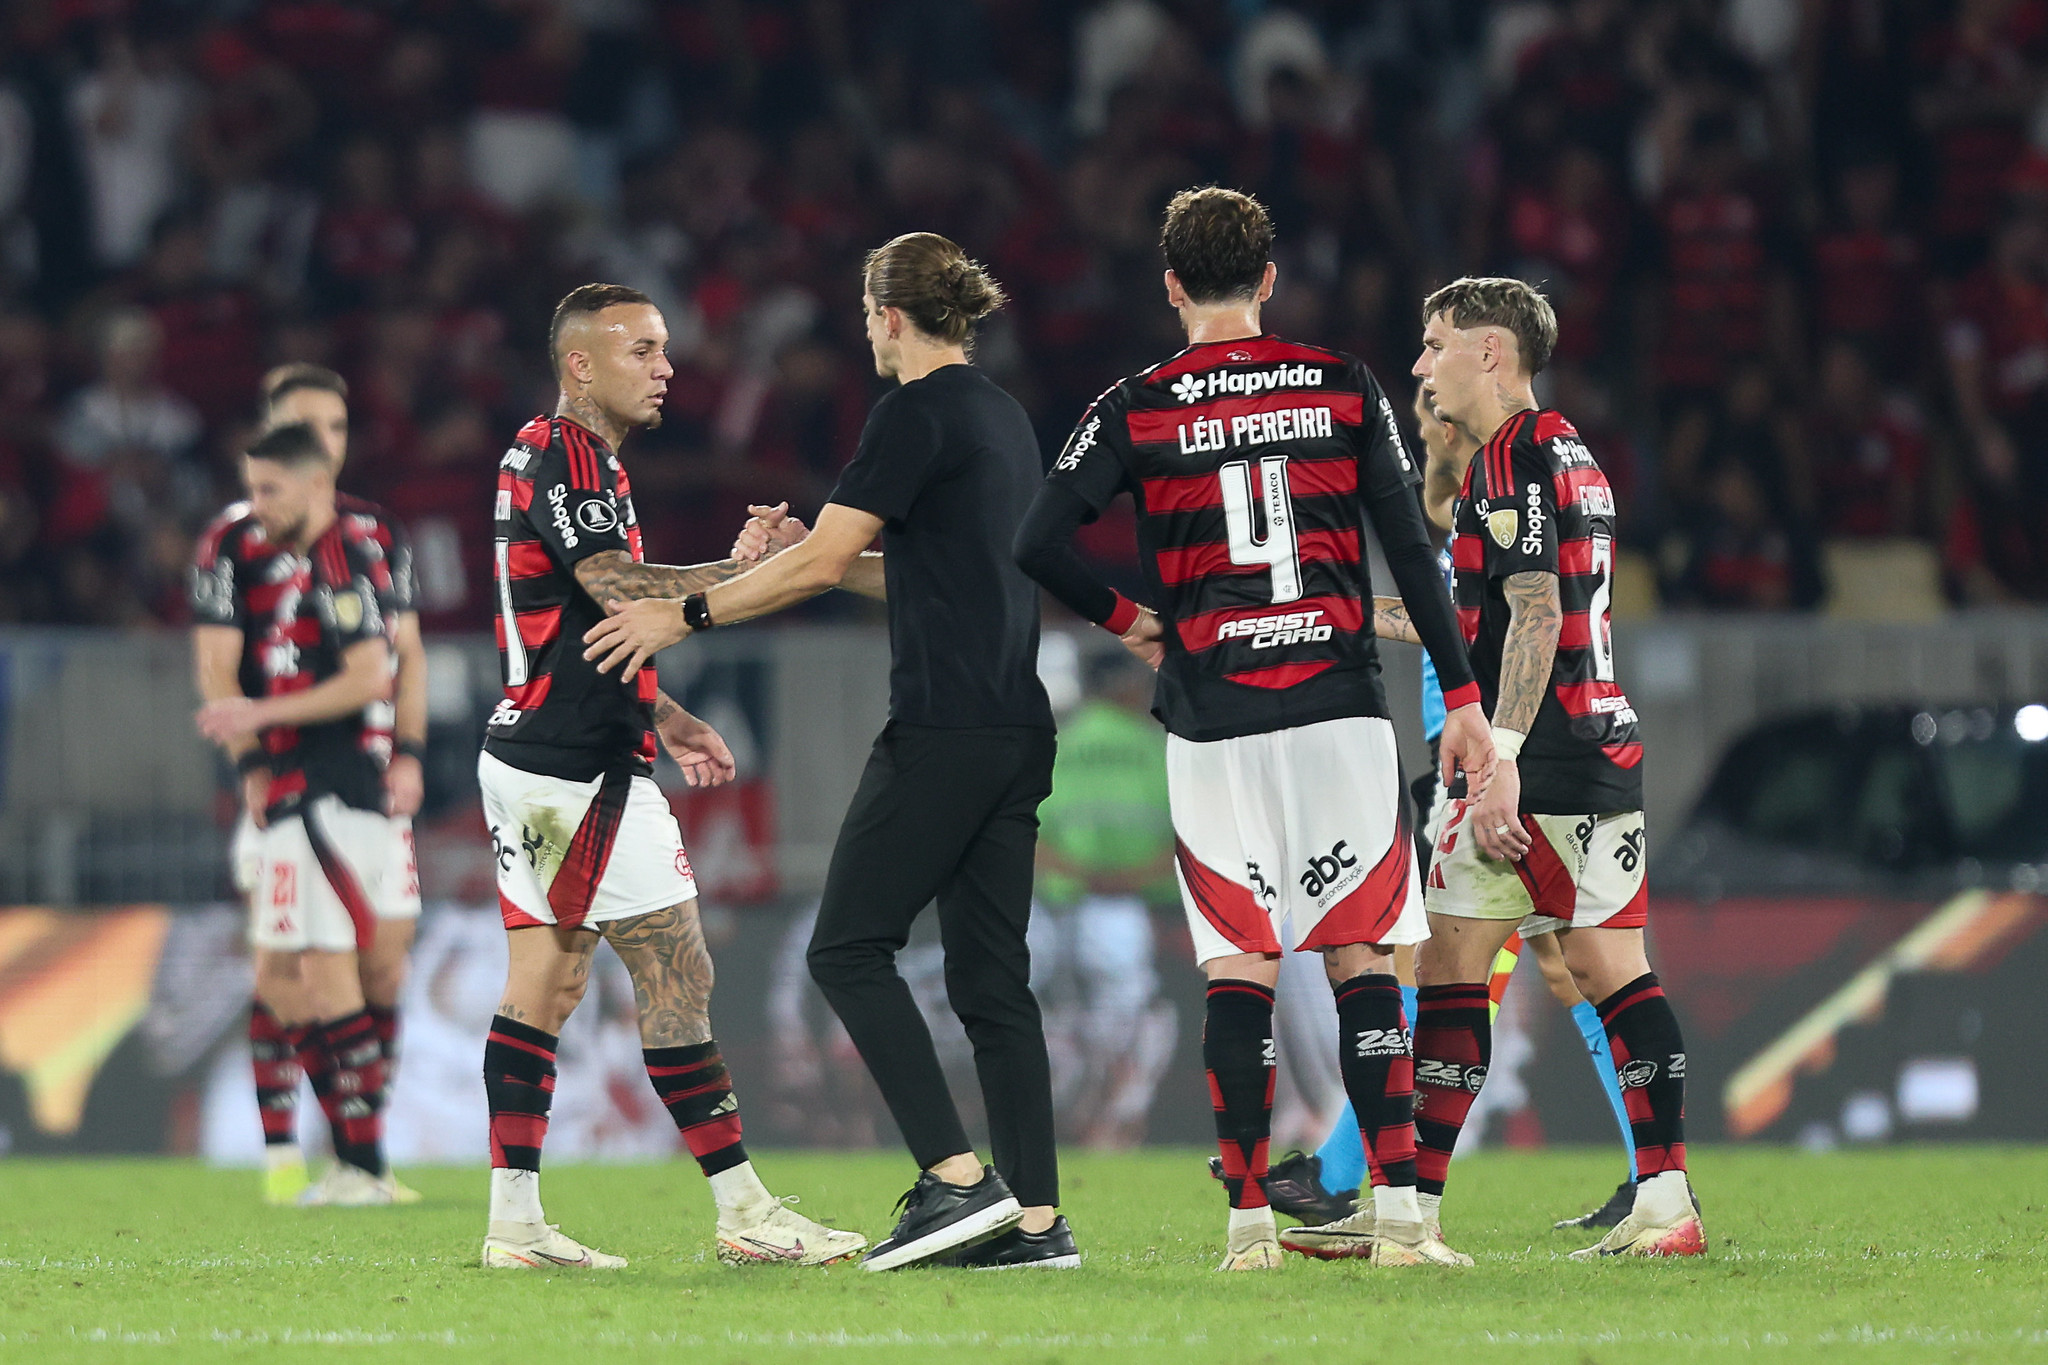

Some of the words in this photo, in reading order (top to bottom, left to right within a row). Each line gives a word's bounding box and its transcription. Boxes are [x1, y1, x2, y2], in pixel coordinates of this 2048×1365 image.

[1207, 363, 1323, 396] Hapvida
[1177, 415, 1226, 455] LÉO
[1231, 407, 1333, 447] PEREIRA
[1270, 472, 1281, 513] TEXACO
[547, 483, 579, 549] Shopee
[1219, 455, 1304, 603] 4
[1521, 482, 1547, 556] Shopee
[1217, 610, 1325, 642] ASSIST
[1589, 532, 1615, 683] 2
[1251, 625, 1333, 651] CARD
[1299, 839, 1358, 898] abc
[1613, 827, 1646, 873] ab
[1356, 1027, 1405, 1050] Zé
[1357, 1047, 1406, 1058] DELIVERY
[1415, 1074, 1462, 1088] DELIVERY
[1416, 1059, 1463, 1082] Zé
